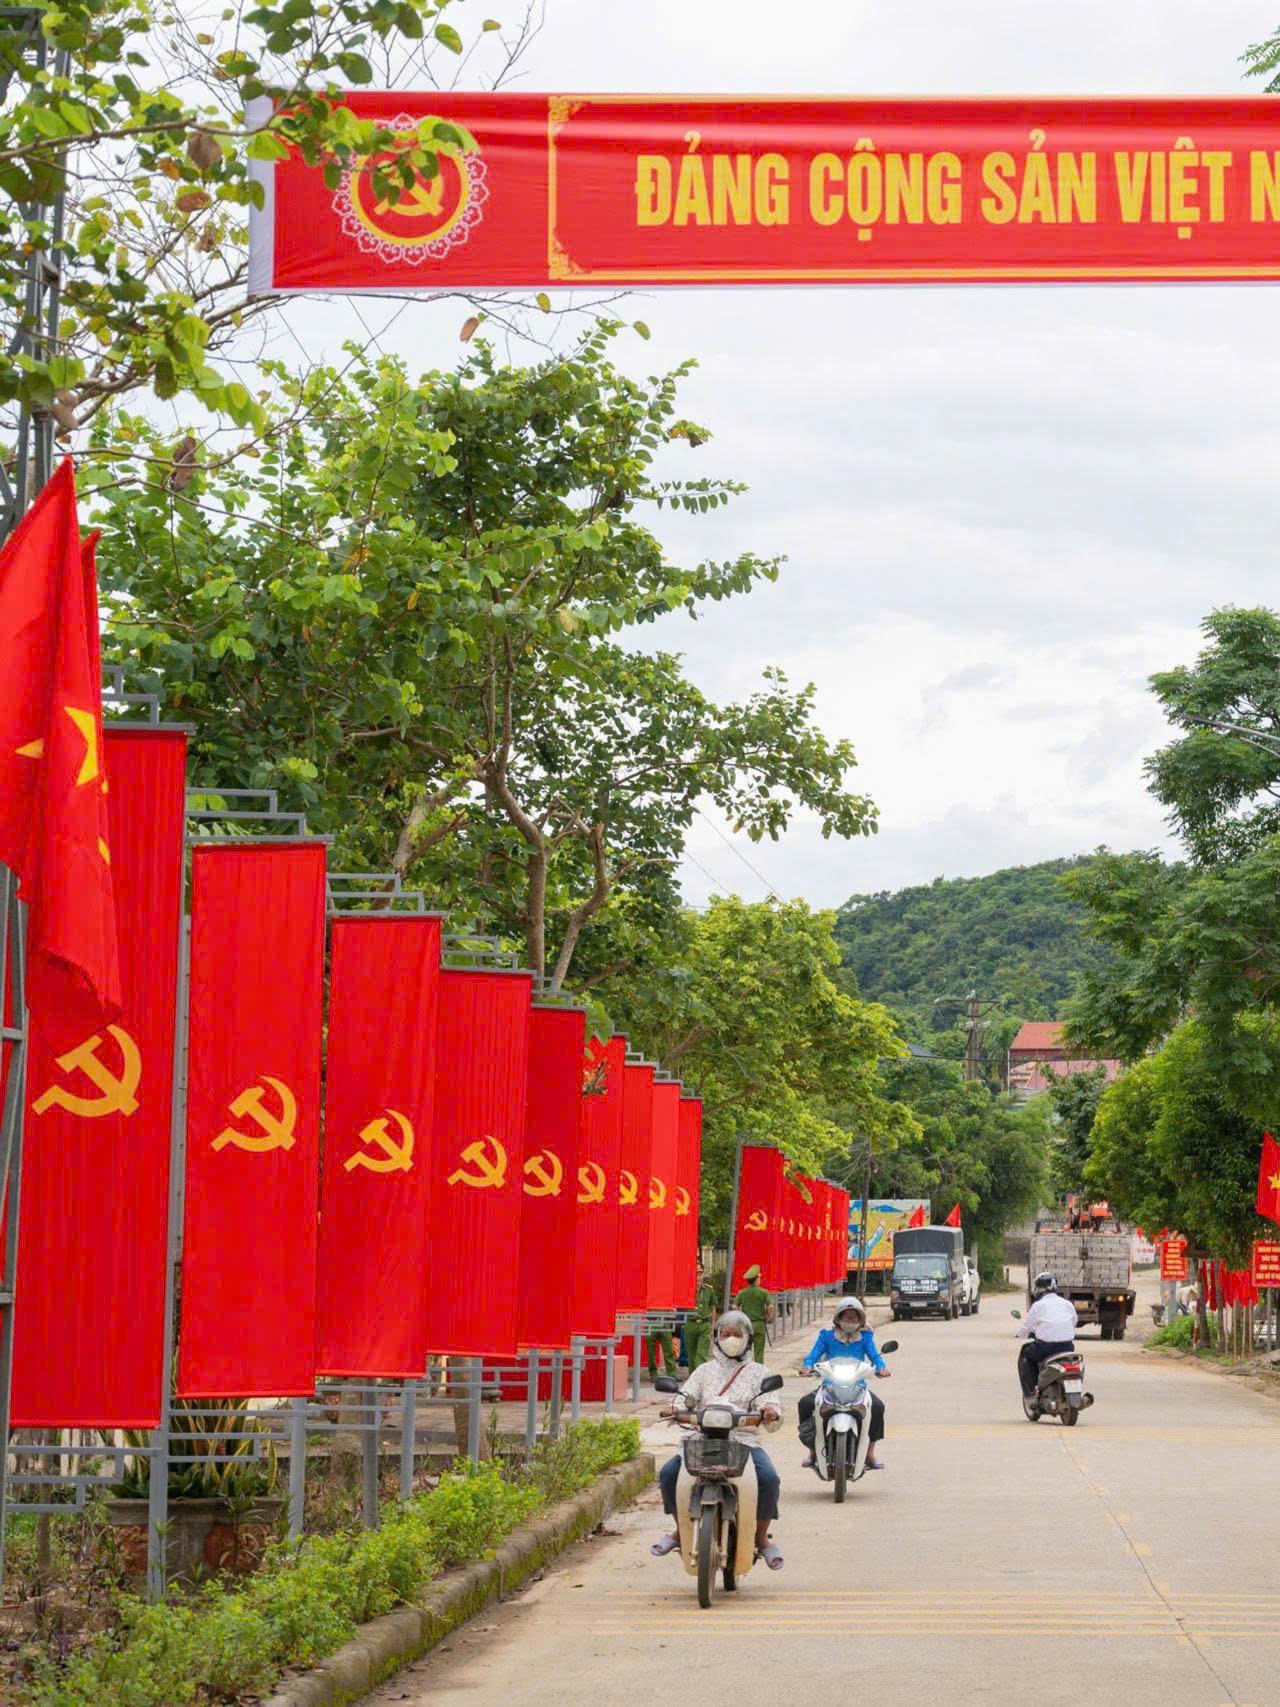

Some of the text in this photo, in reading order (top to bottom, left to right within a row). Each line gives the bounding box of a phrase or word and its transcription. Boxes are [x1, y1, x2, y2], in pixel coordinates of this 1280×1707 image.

[635, 129, 789, 226] ĐẢNG
[808, 137, 962, 241] CỘNG
[981, 128, 1096, 223] SẢN
[1115, 136, 1231, 239] VIỆT
